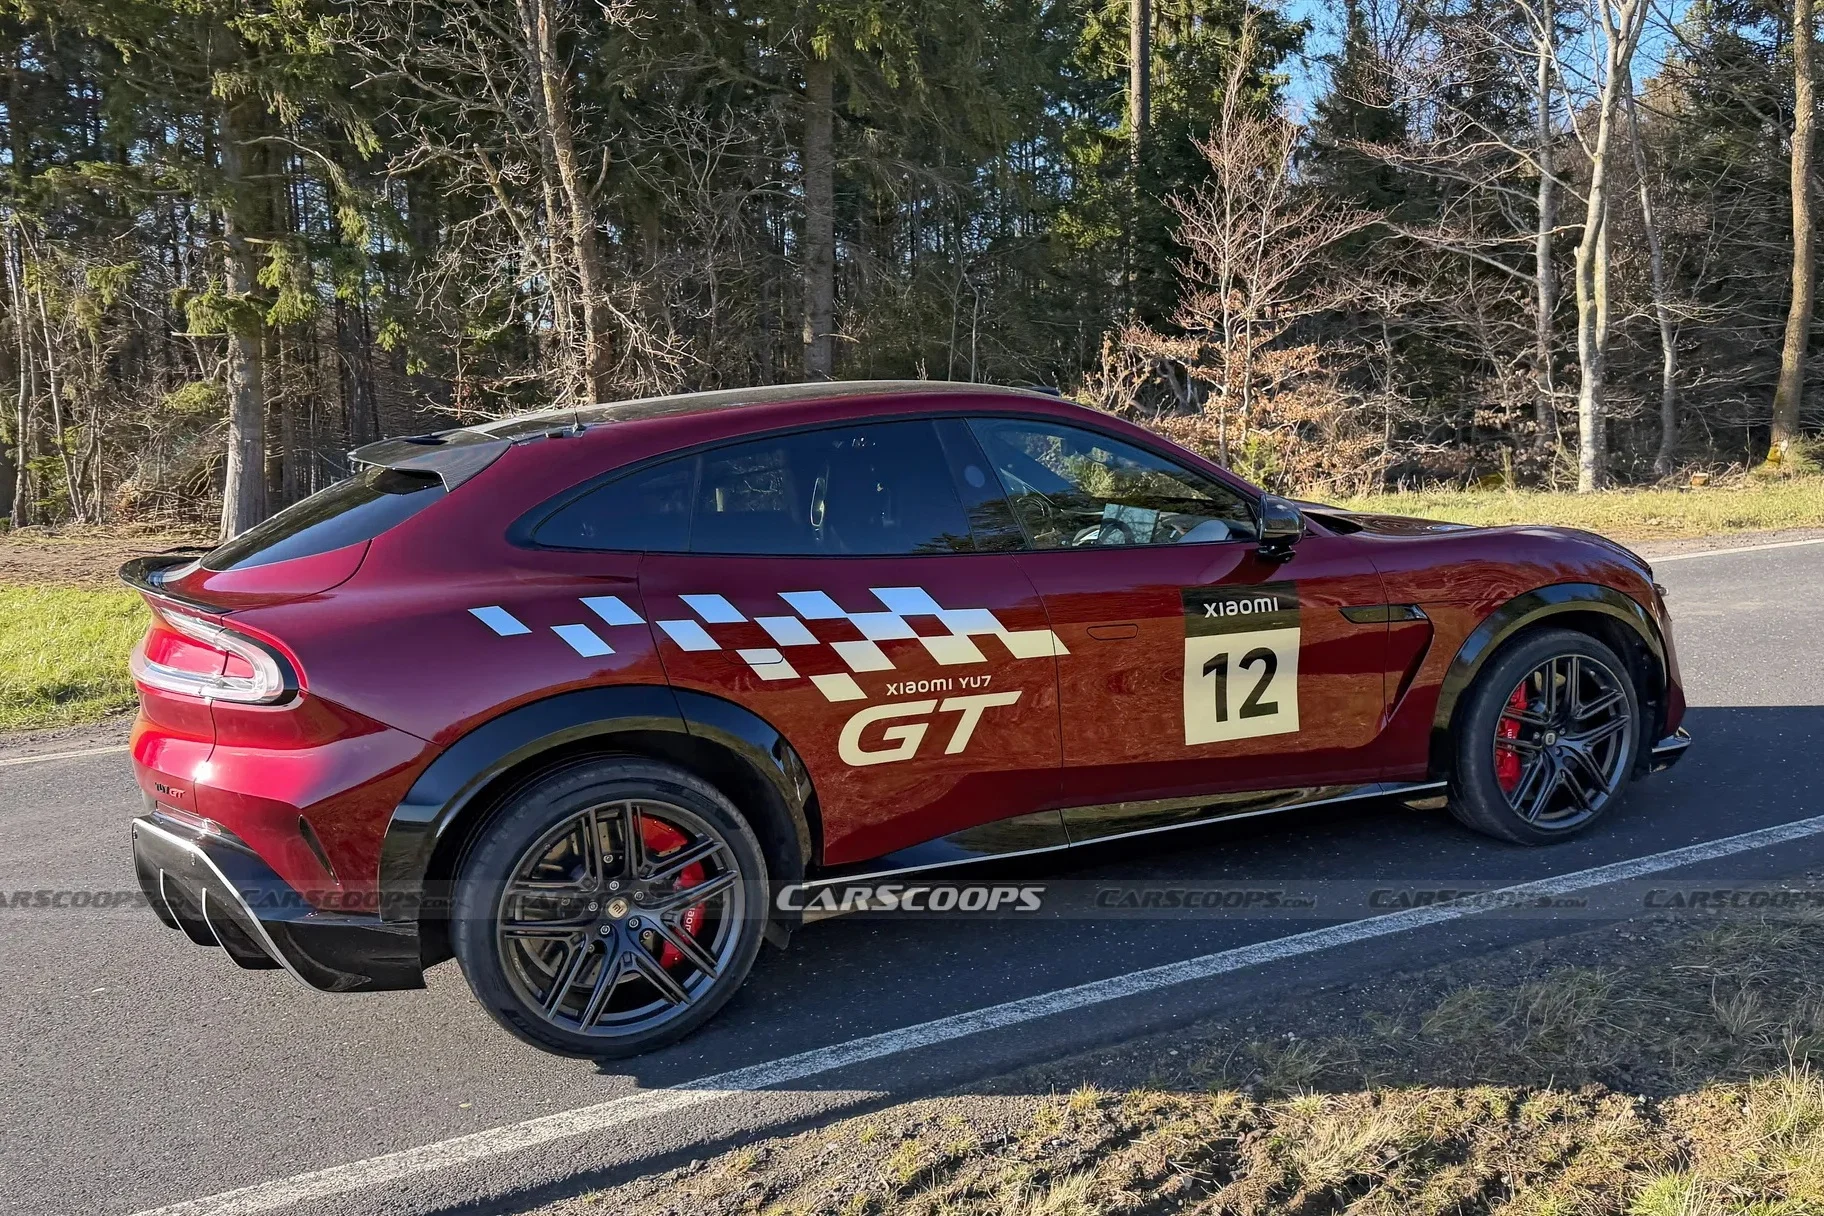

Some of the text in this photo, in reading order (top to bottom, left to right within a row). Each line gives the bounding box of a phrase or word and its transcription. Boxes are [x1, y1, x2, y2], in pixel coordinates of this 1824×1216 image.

[959, 675, 992, 689] YU7
[1202, 647, 1279, 723] 12
[838, 690, 1023, 767] GT
